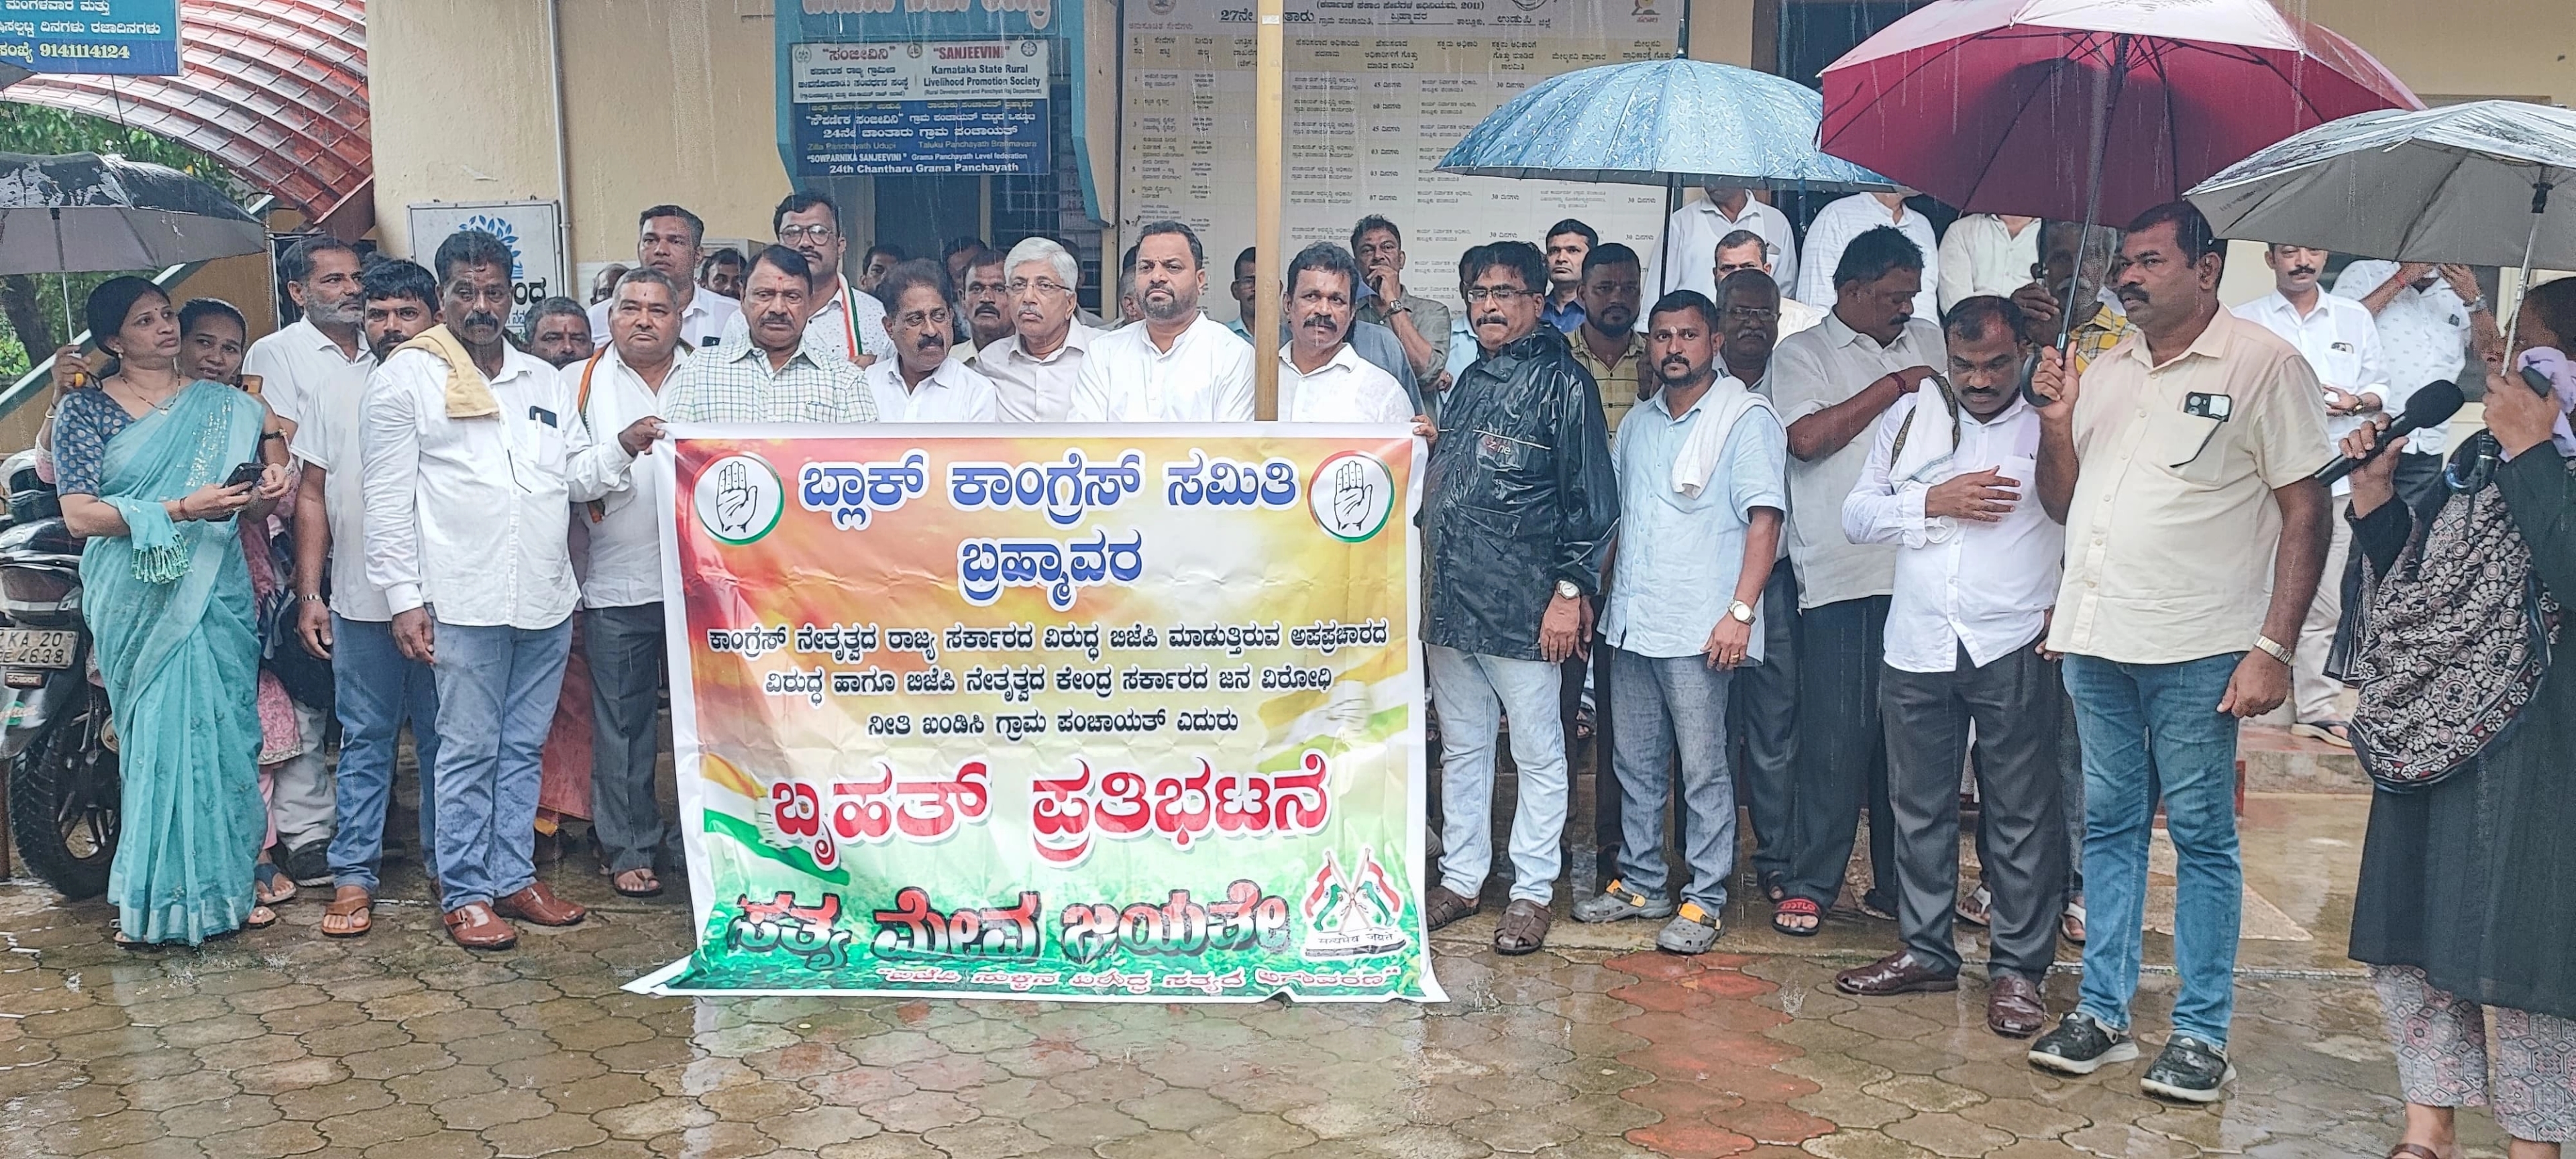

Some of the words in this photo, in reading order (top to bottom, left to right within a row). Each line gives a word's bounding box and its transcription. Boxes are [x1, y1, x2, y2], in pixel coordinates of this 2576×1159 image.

[1284, 9, 1315, 22] ತಾರು
[40, 44, 129, 59] 9141114124
[932, 65, 976, 74] Karnataka
[979, 64, 1002, 73] State
[1006, 64, 1028, 73] Rural
[924, 77, 964, 87] Livelihood
[967, 77, 1008, 86] Promotion
[1010, 76, 1040, 87] Society
[873, 142, 896, 150] Udupi
[945, 140, 989, 149] Panchayath
[935, 153, 973, 162] Panchayath
[830, 164, 853, 174] 24th
[857, 164, 912, 174] Chantharu
[916, 164, 951, 173] Grama
[955, 163, 1019, 174] Panchayath
[803, 454, 924, 525] ಬ್ಲಾಕ್
[951, 452, 1140, 525] ಕಾಂಗ್ರೆಸ್
[1167, 453, 1297, 507] ಸಮಿತಿ
[962, 528, 1142, 606] ಬ್ರಹ್ಮಾವರ
[8, 632, 29, 647] KA
[39, 632, 62, 647] 20
[708, 626, 786, 657] ಕಾಂಗ್ರೆಸ್
[797, 624, 876, 661] ನೇತೃತ್ವದ
[888, 626, 936, 661] ರಾಜ್ಯ
[946, 624, 1033, 649] ಸರ್ಕಾರದ
[1044, 624, 1099, 660] ವಿರುದ್ಧ
[1110, 624, 1159, 648] ಬಿಜೆಪಿ
[1169, 622, 1280, 655] ಮಾಡುತ್ತಿರುವ
[1290, 620, 1387, 653] ಅಪಪ್ರಚಾರದ
[17, 649, 64, 663] 4638
[765, 668, 824, 706] ವಿರುದ್ಧ
[833, 669, 896, 694] ಹಾಗೂ
[907, 668, 955, 693] ಬಿಜೆಪಿ
[966, 667, 1045, 702] ನೇತೃತ್ವದ
[1056, 665, 1112, 698] ಕೇಂದ್ರ
[1122, 666, 1208, 691] ಸರ್ಕಾರದ
[1219, 666, 1250, 689] ಜನ
[1261, 665, 1332, 692] ವಿರೋಧಿ
[868, 714, 911, 735] ನೀತಿ
[922, 713, 984, 735] ಖಂಡಿಸಿ
[996, 710, 1047, 742] ಗ್ರಾಮ
[1057, 708, 1166, 733] ಪಂಚಾಯತ್
[1177, 708, 1239, 732] ಎದುರು
[772, 761, 988, 867] ಬೃಹತ್
[1032, 753, 1327, 863] ಪ್ರತಿಭಟನೆ
[727, 890, 852, 971] ಸತ್ಯ
[870, 885, 1042, 963] ಮೇವ
[1061, 879, 1290, 964] ಜಯತೇ
